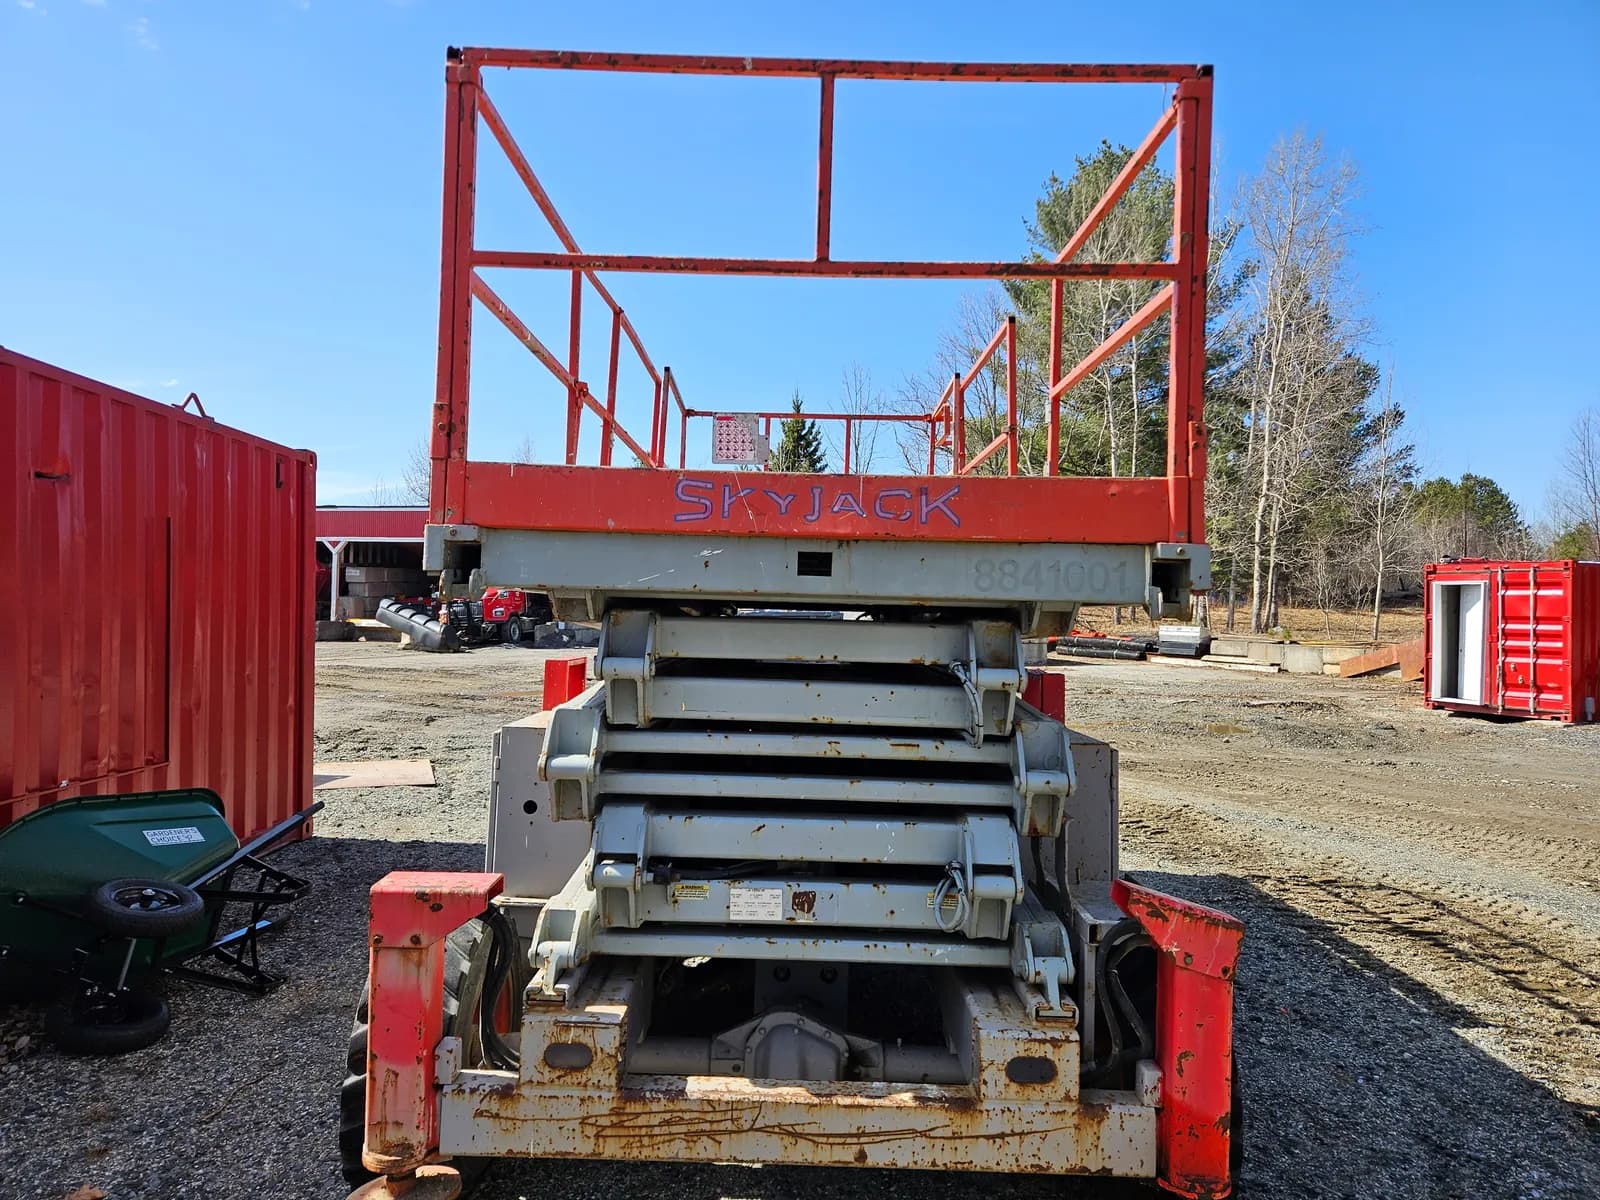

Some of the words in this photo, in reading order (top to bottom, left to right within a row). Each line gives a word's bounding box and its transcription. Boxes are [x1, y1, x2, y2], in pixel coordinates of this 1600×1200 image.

[674, 478, 960, 528] SKYJACK
[974, 559, 1129, 594] 8841001
[150, 835, 181, 844] CHOICE
